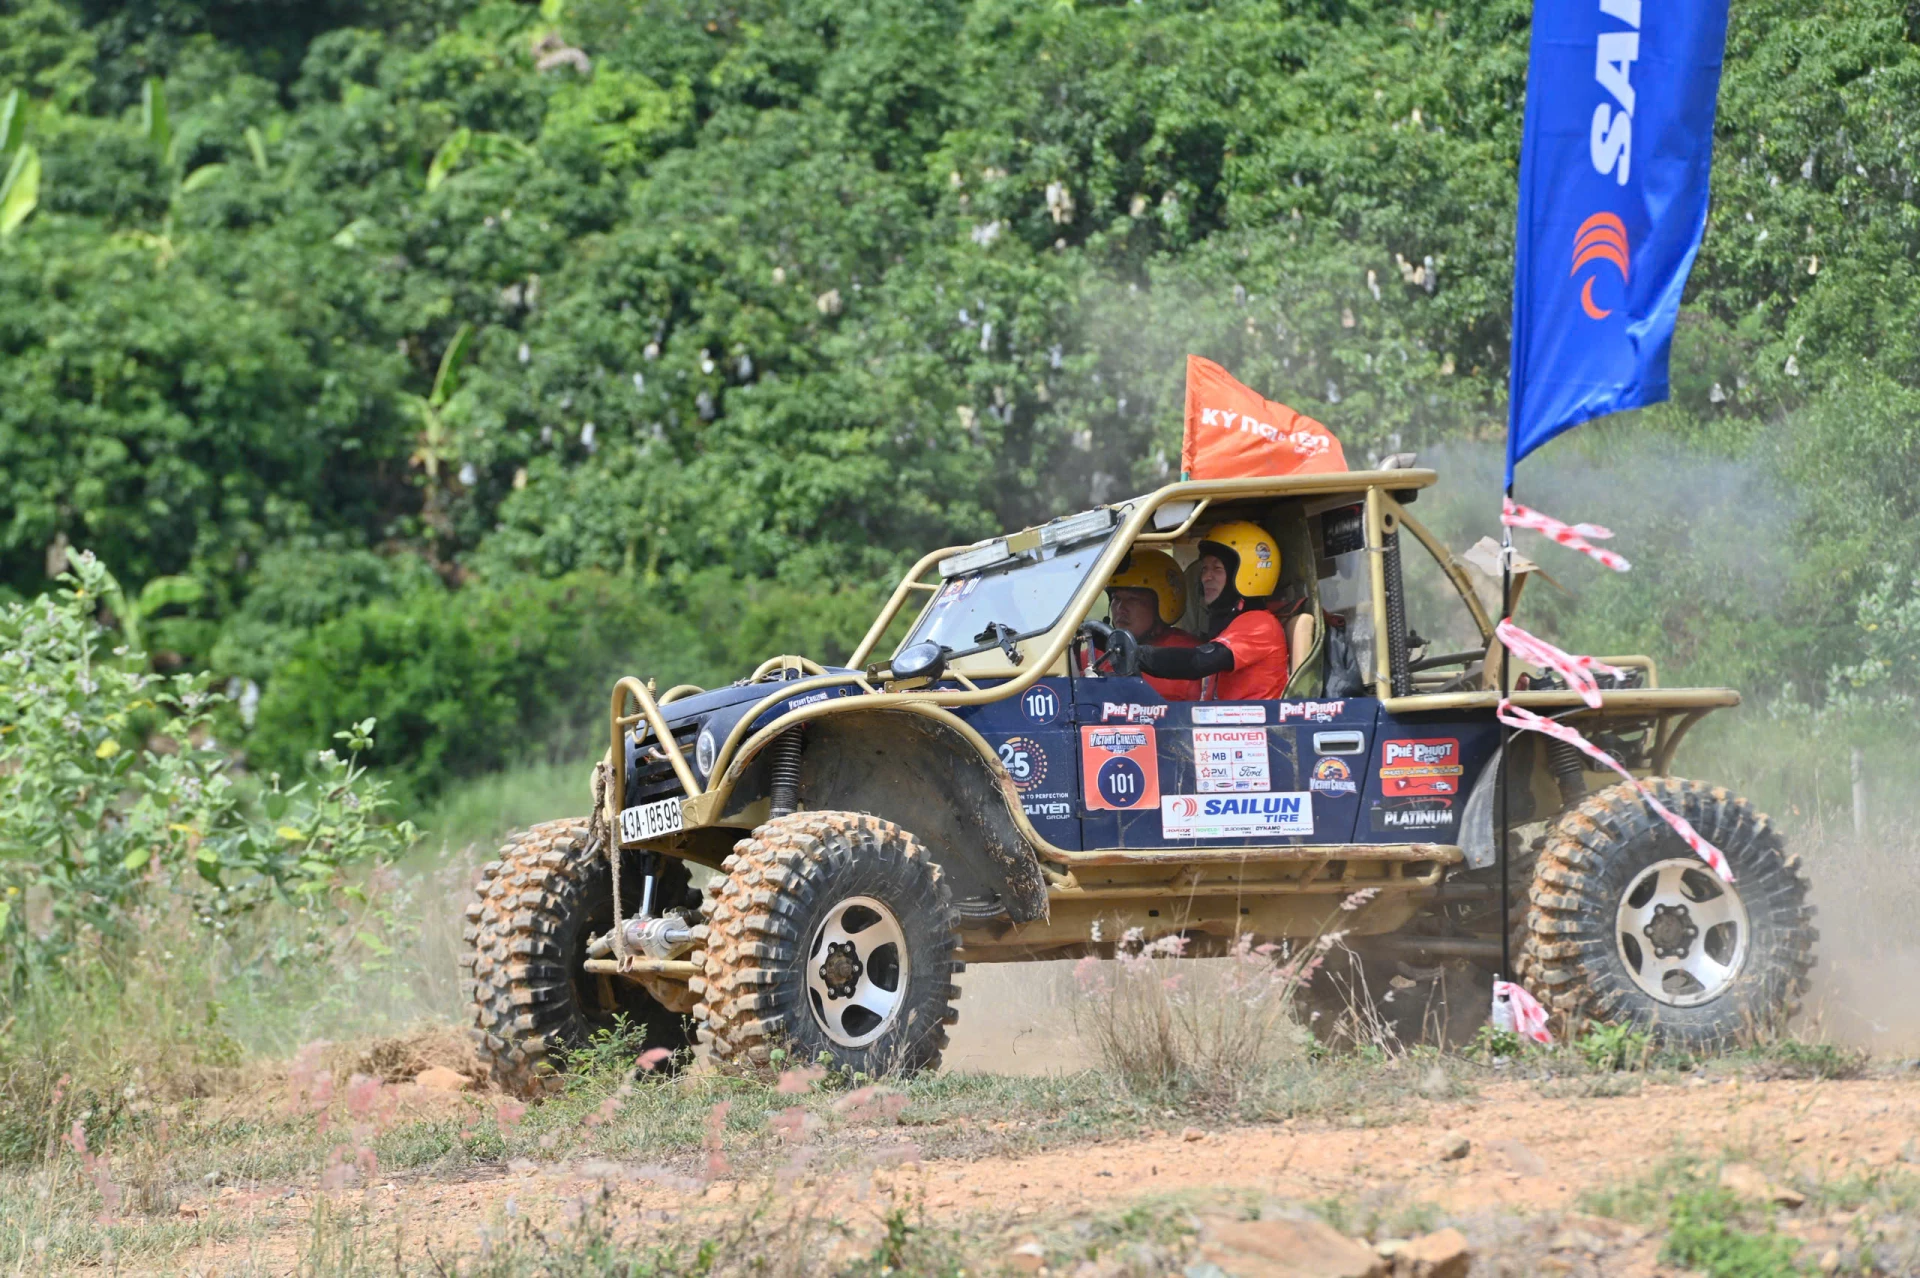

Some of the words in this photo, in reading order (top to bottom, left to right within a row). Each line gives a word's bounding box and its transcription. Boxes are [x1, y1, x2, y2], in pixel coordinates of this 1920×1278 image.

[1026, 694, 1054, 716] 101
[1102, 702, 1127, 722] PHÊ
[1279, 702, 1305, 723] PHÊ
[998, 743, 1030, 777] 25
[1212, 752, 1227, 761] MB
[1386, 743, 1412, 765] PHÊ
[1239, 765, 1263, 777] Ford
[1108, 773, 1135, 794] 101
[1035, 792, 1069, 800] PERFECTION
[1204, 797, 1301, 816] SAILUN
[1264, 814, 1299, 823] TIRE
[1384, 809, 1453, 826] PLATINUM
